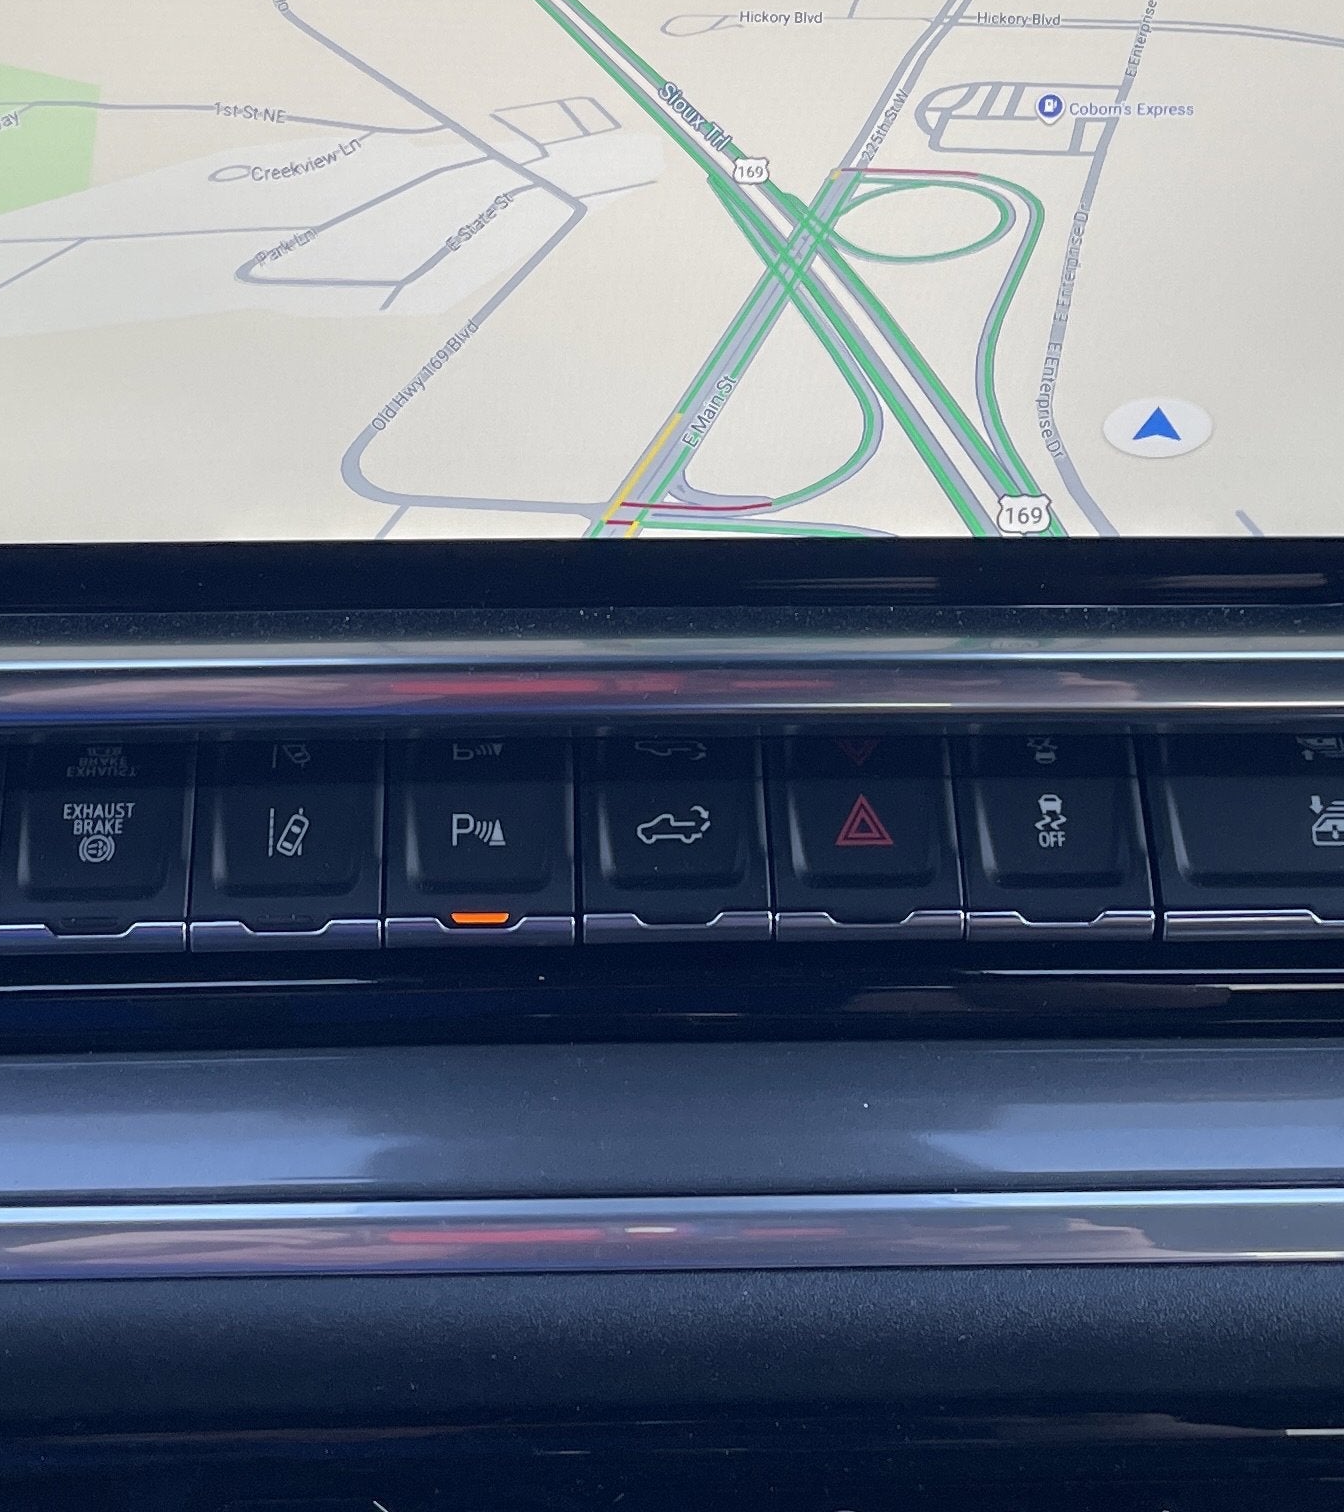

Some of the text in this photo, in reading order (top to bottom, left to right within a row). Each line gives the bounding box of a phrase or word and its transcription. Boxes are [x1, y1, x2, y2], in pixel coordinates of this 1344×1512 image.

[739, 11, 823, 27] Hickory Blvd
[977, 11, 1061, 28] Hickory Blvd
[214, 102, 287, 124] 1st St NE
[659, 82, 733, 151] Sioux Trl
[1137, 102, 1195, 119] Express
[861, 125, 890, 162] 225th
[251, 137, 362, 182] Creekview Ln
[737, 165, 764, 179] 169
[371, 318, 479, 431] Old Hwy 169 Blvd
[1035, 355, 1060, 439] Enterprise
[681, 375, 737, 448] E Main St
[1046, 440, 1064, 459] Dr
[1005, 506, 1043, 524] 169
[63, 802, 136, 820] EXHAUST
[72, 819, 124, 836] BRAKE
[1038, 831, 1066, 848] OFF
